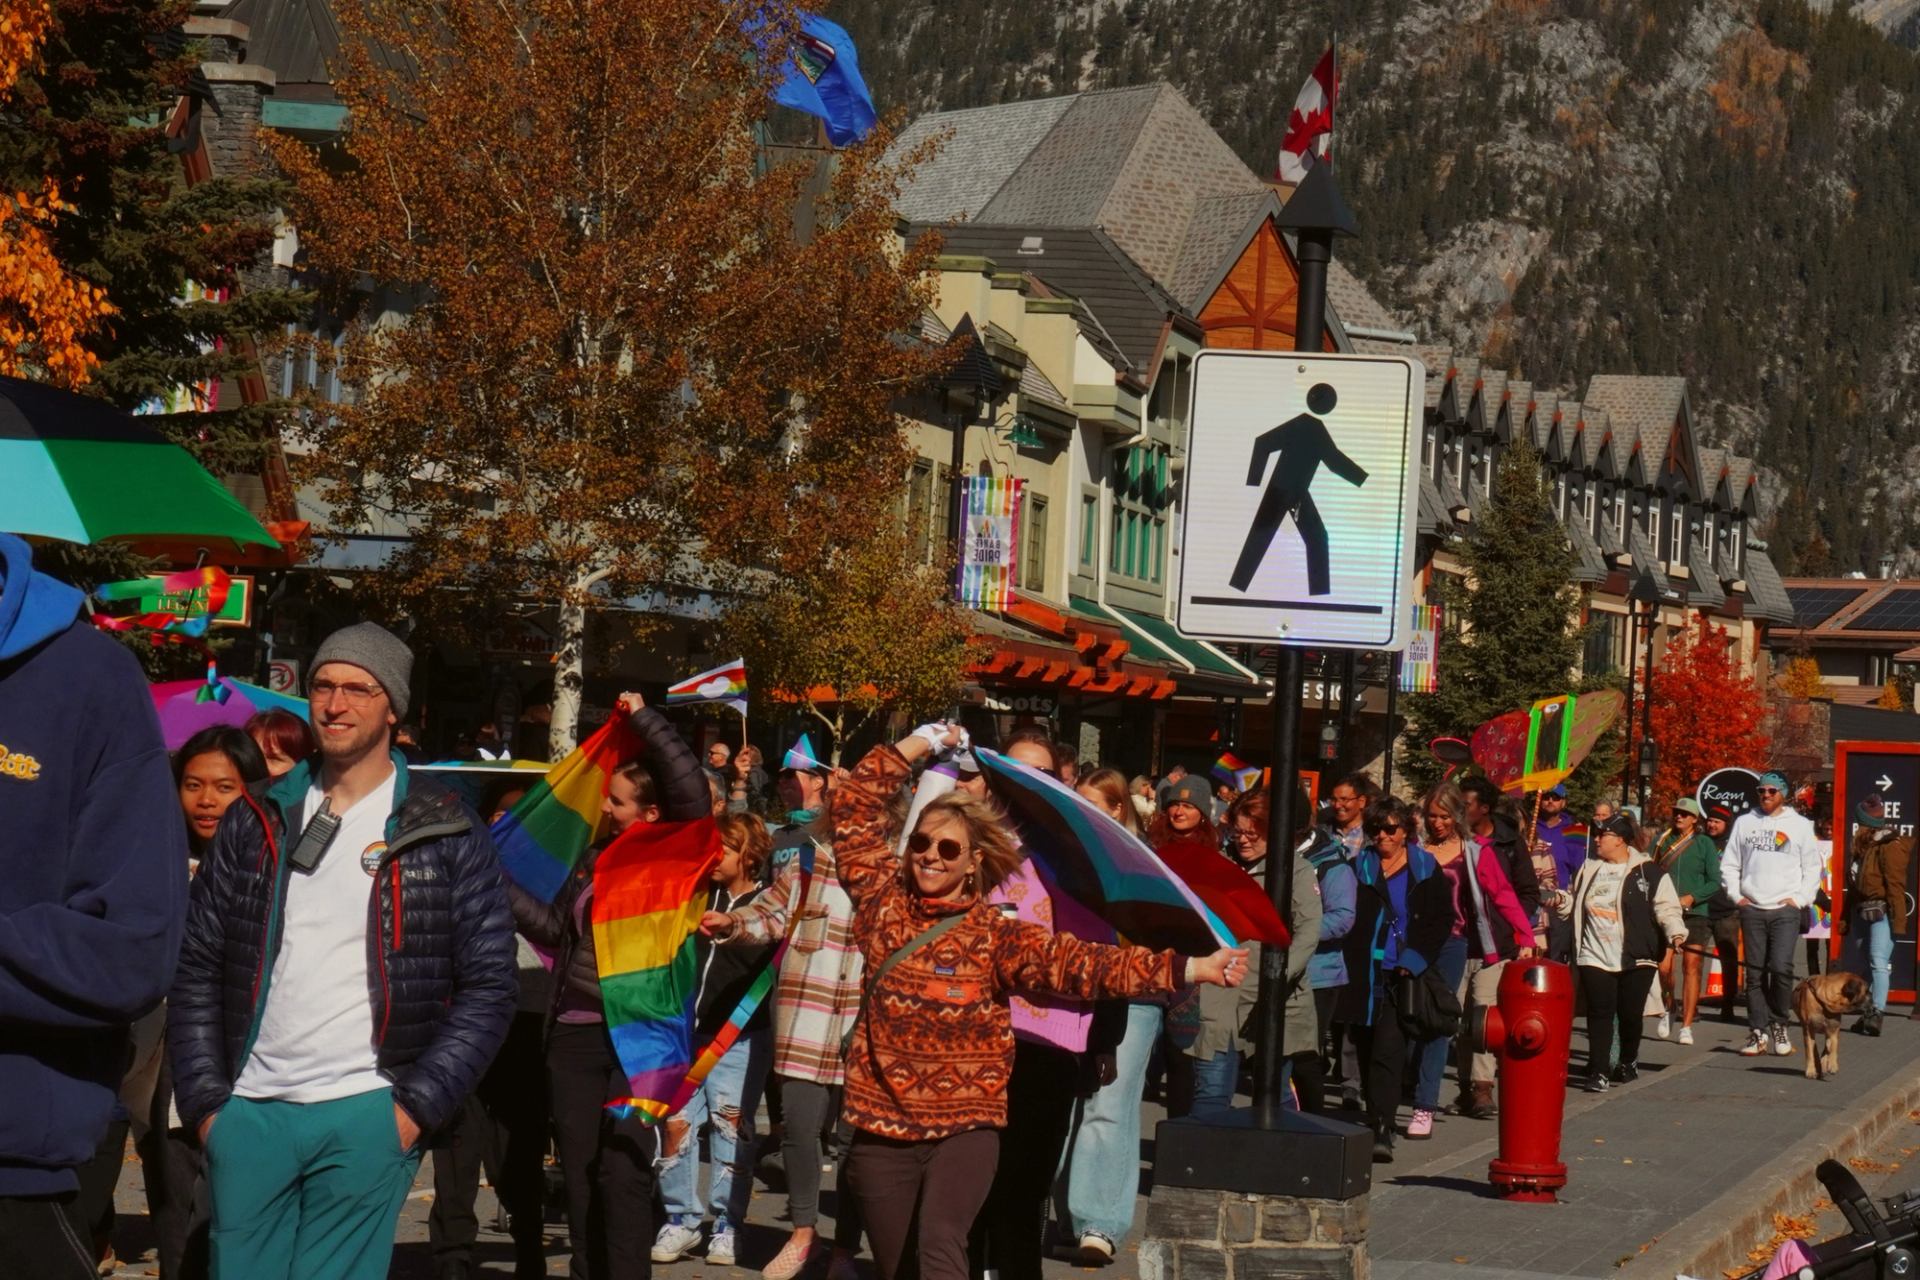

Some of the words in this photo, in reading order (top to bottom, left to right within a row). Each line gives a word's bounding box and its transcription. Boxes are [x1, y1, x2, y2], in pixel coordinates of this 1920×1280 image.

[1702, 784, 1745, 800] Roam
[1745, 836, 1776, 846] NORTH
[1752, 843, 1776, 852] FACE
